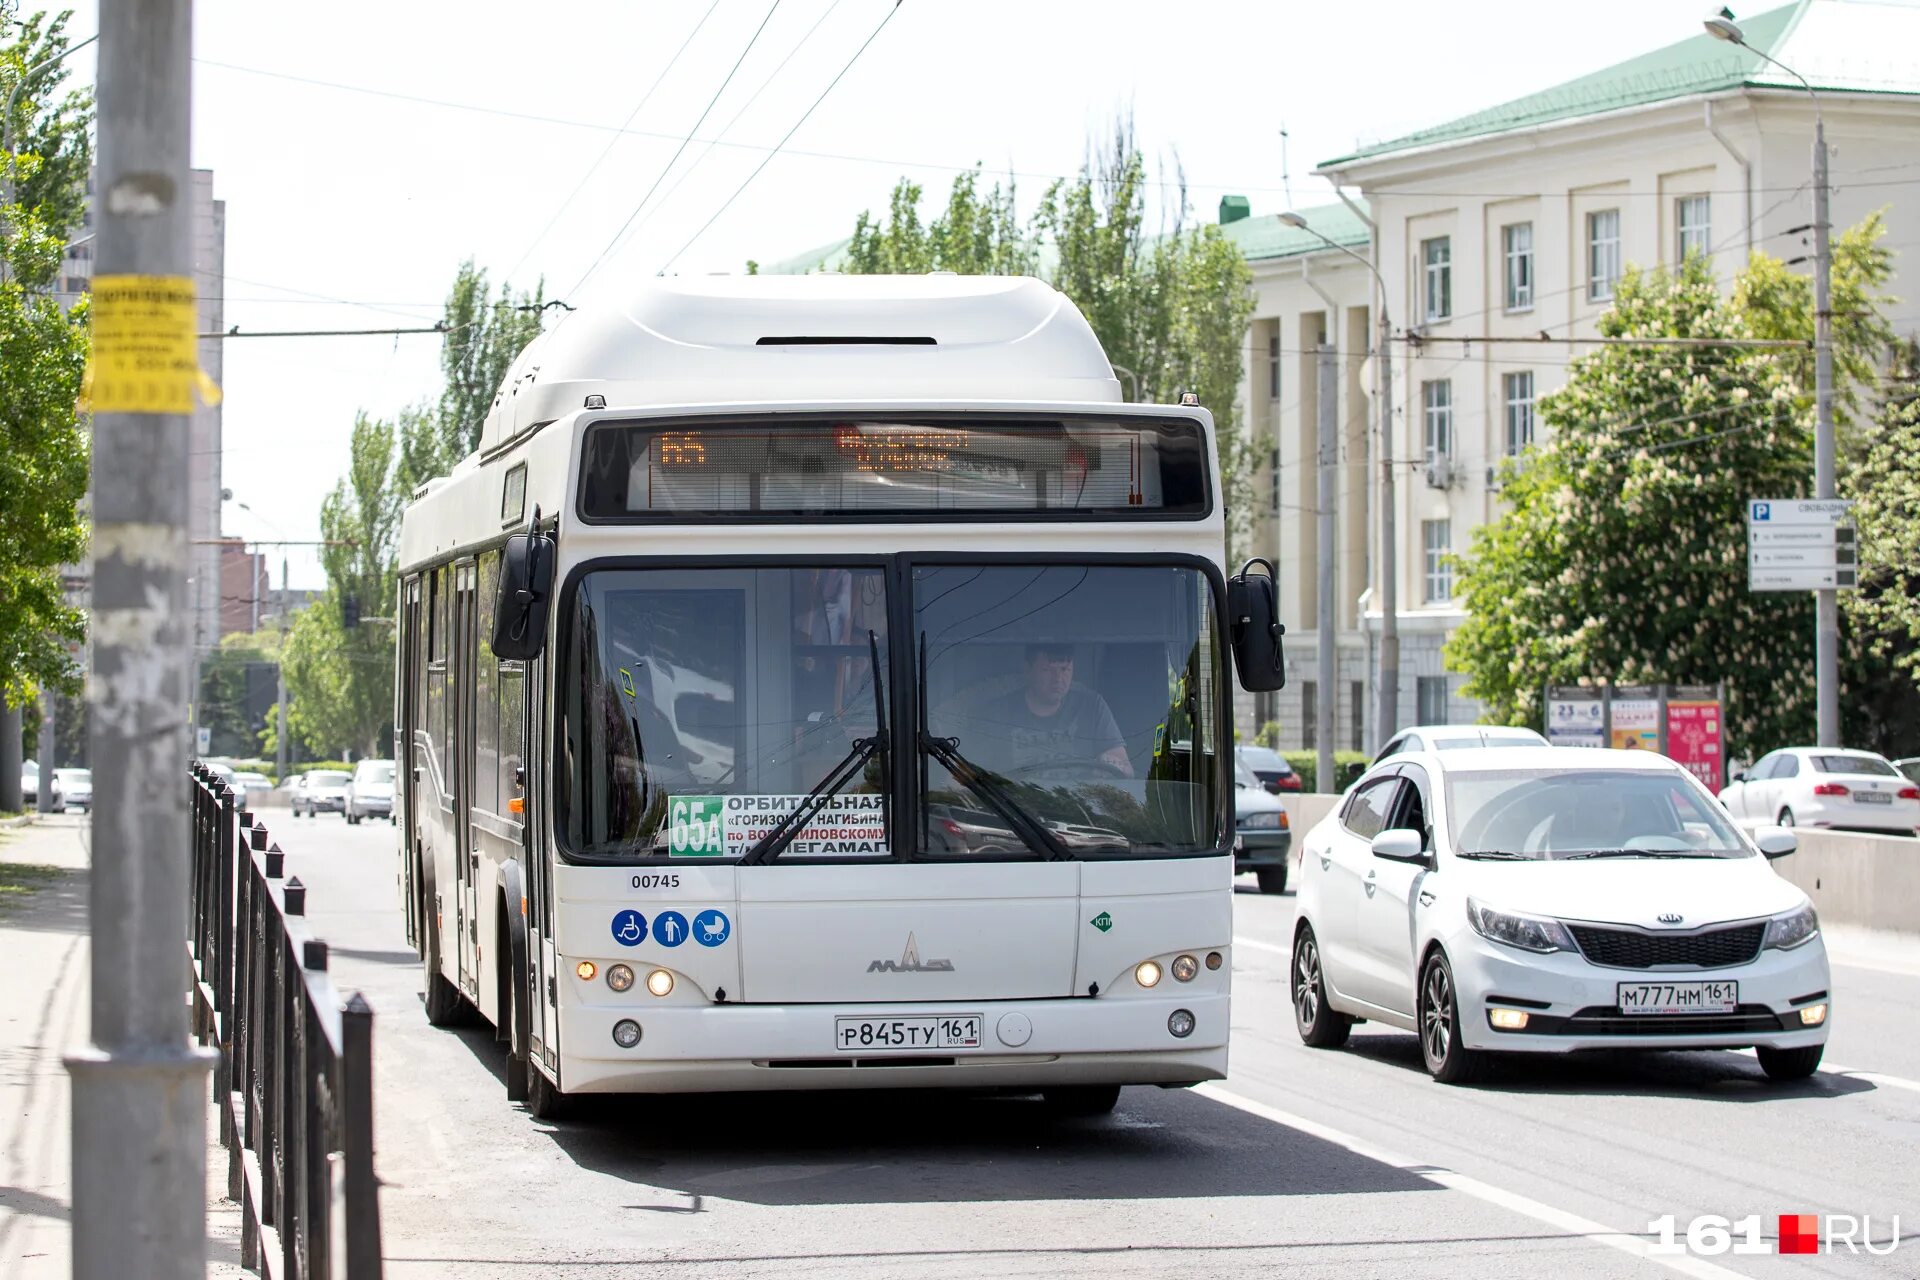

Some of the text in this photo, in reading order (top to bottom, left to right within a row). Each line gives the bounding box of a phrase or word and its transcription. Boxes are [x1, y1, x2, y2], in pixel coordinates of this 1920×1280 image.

[727, 832, 743, 841] по
[632, 875, 680, 888] 00745
[1705, 984, 1731, 999] 161
[941, 1020, 974, 1037] 161
[947, 1037, 964, 1045] RUS
